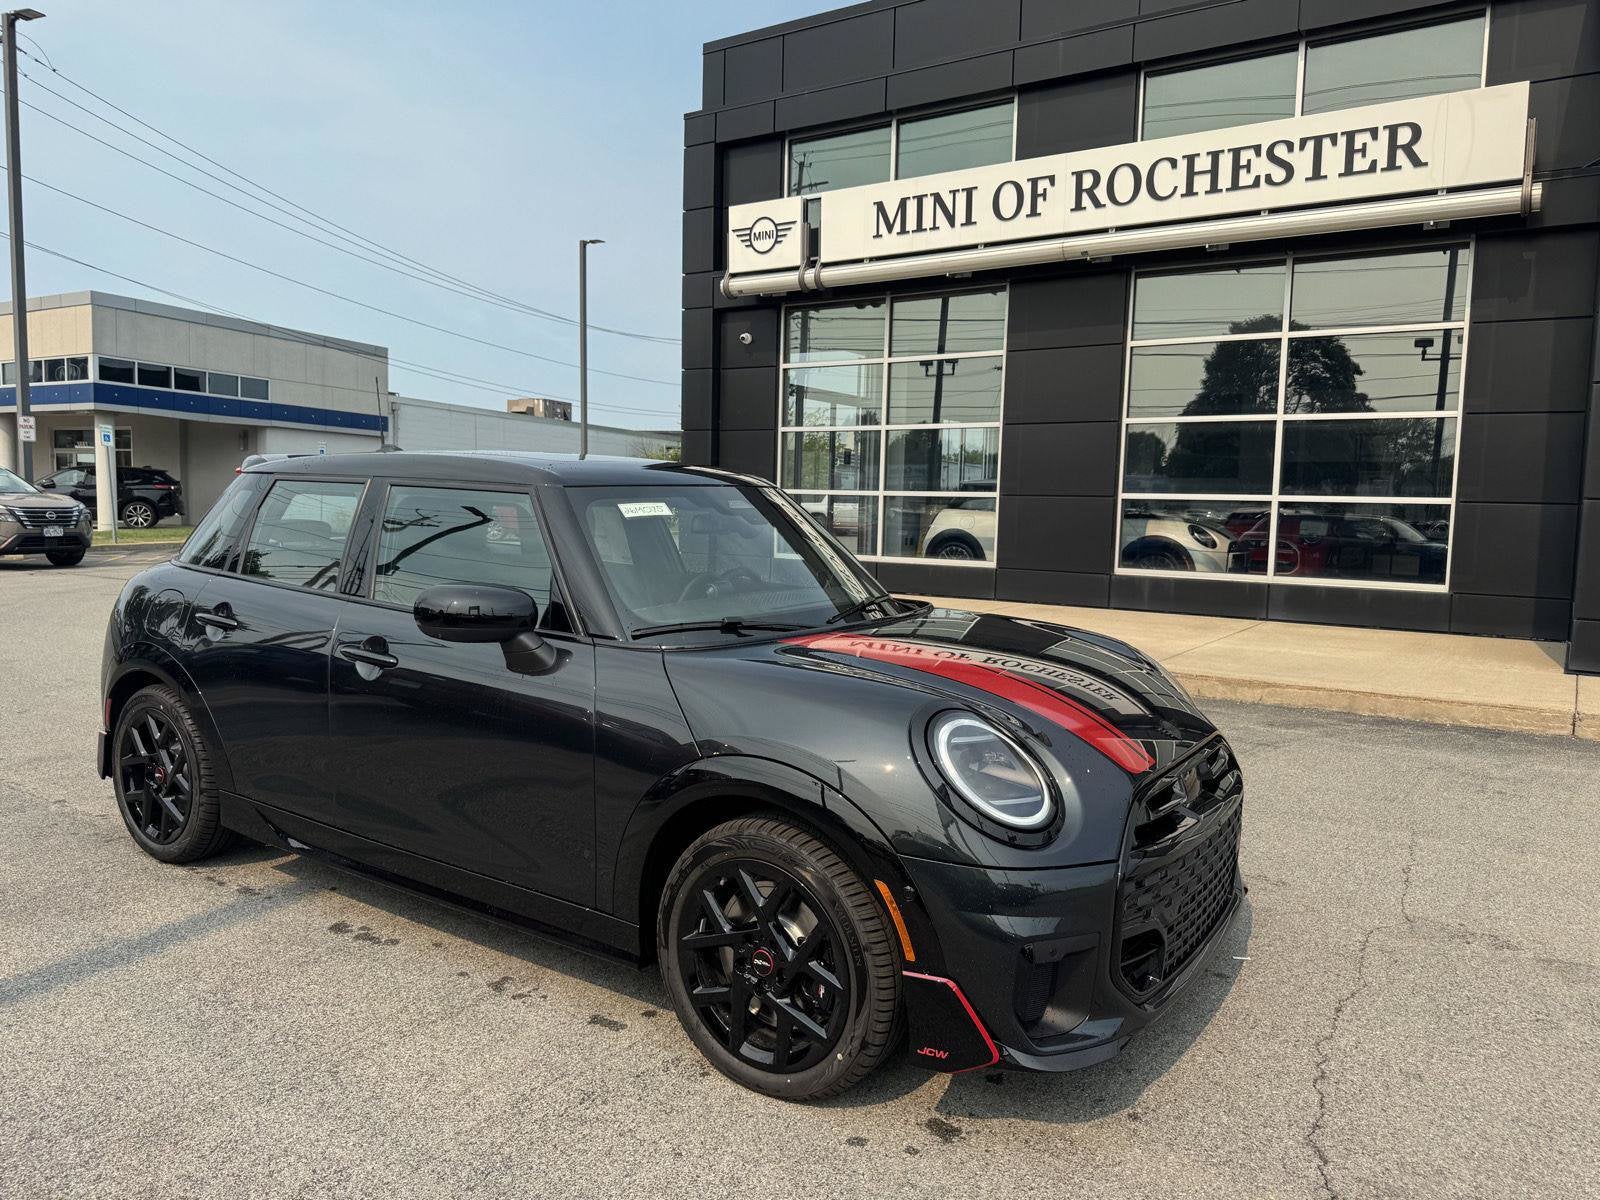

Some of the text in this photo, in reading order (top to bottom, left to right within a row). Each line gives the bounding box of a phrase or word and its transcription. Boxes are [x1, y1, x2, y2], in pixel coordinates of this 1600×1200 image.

[873, 122, 1429, 239] MINI OF ROCHESTER
[753, 230, 774, 242] MINI
[917, 1047, 949, 1059] JCW
